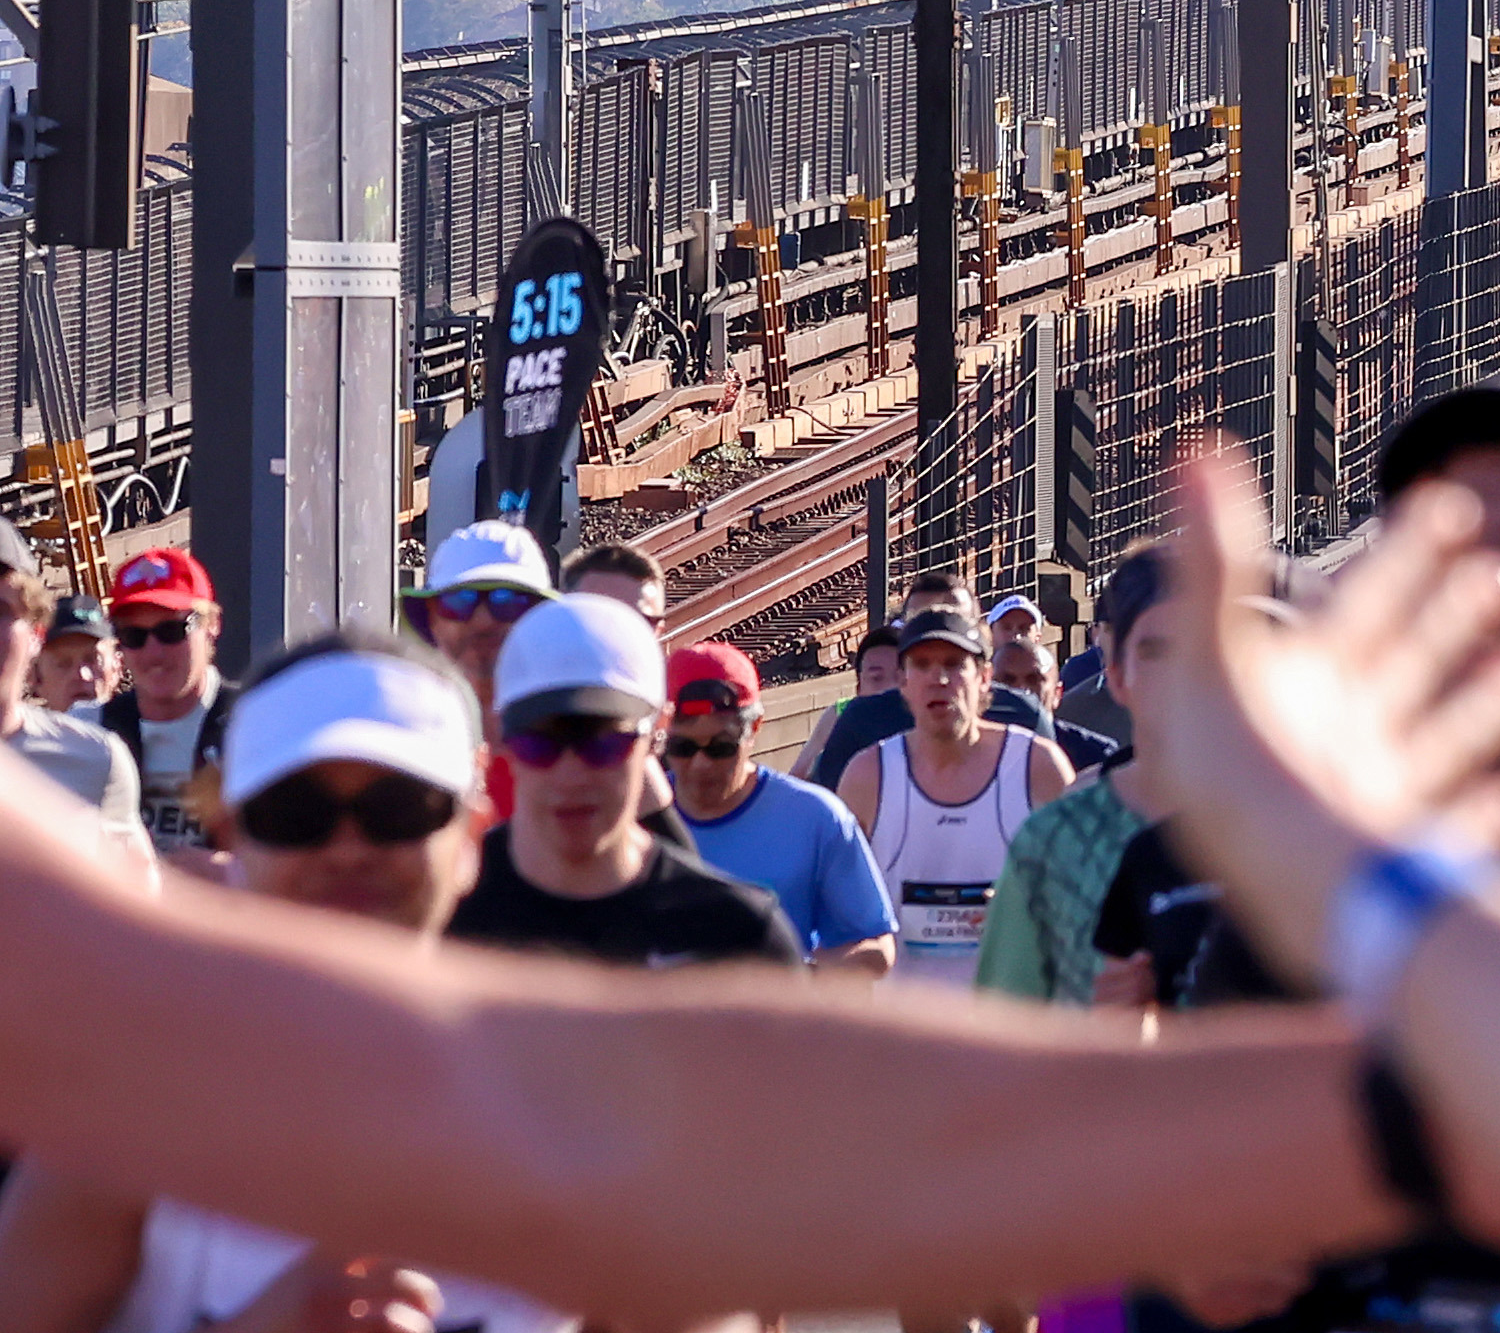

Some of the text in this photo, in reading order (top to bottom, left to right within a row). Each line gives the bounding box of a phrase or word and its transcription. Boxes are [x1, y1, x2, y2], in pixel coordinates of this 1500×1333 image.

[509, 271, 584, 345] 5:15
[505, 345, 567, 395] PACE
[502, 387, 563, 439] TEAM
